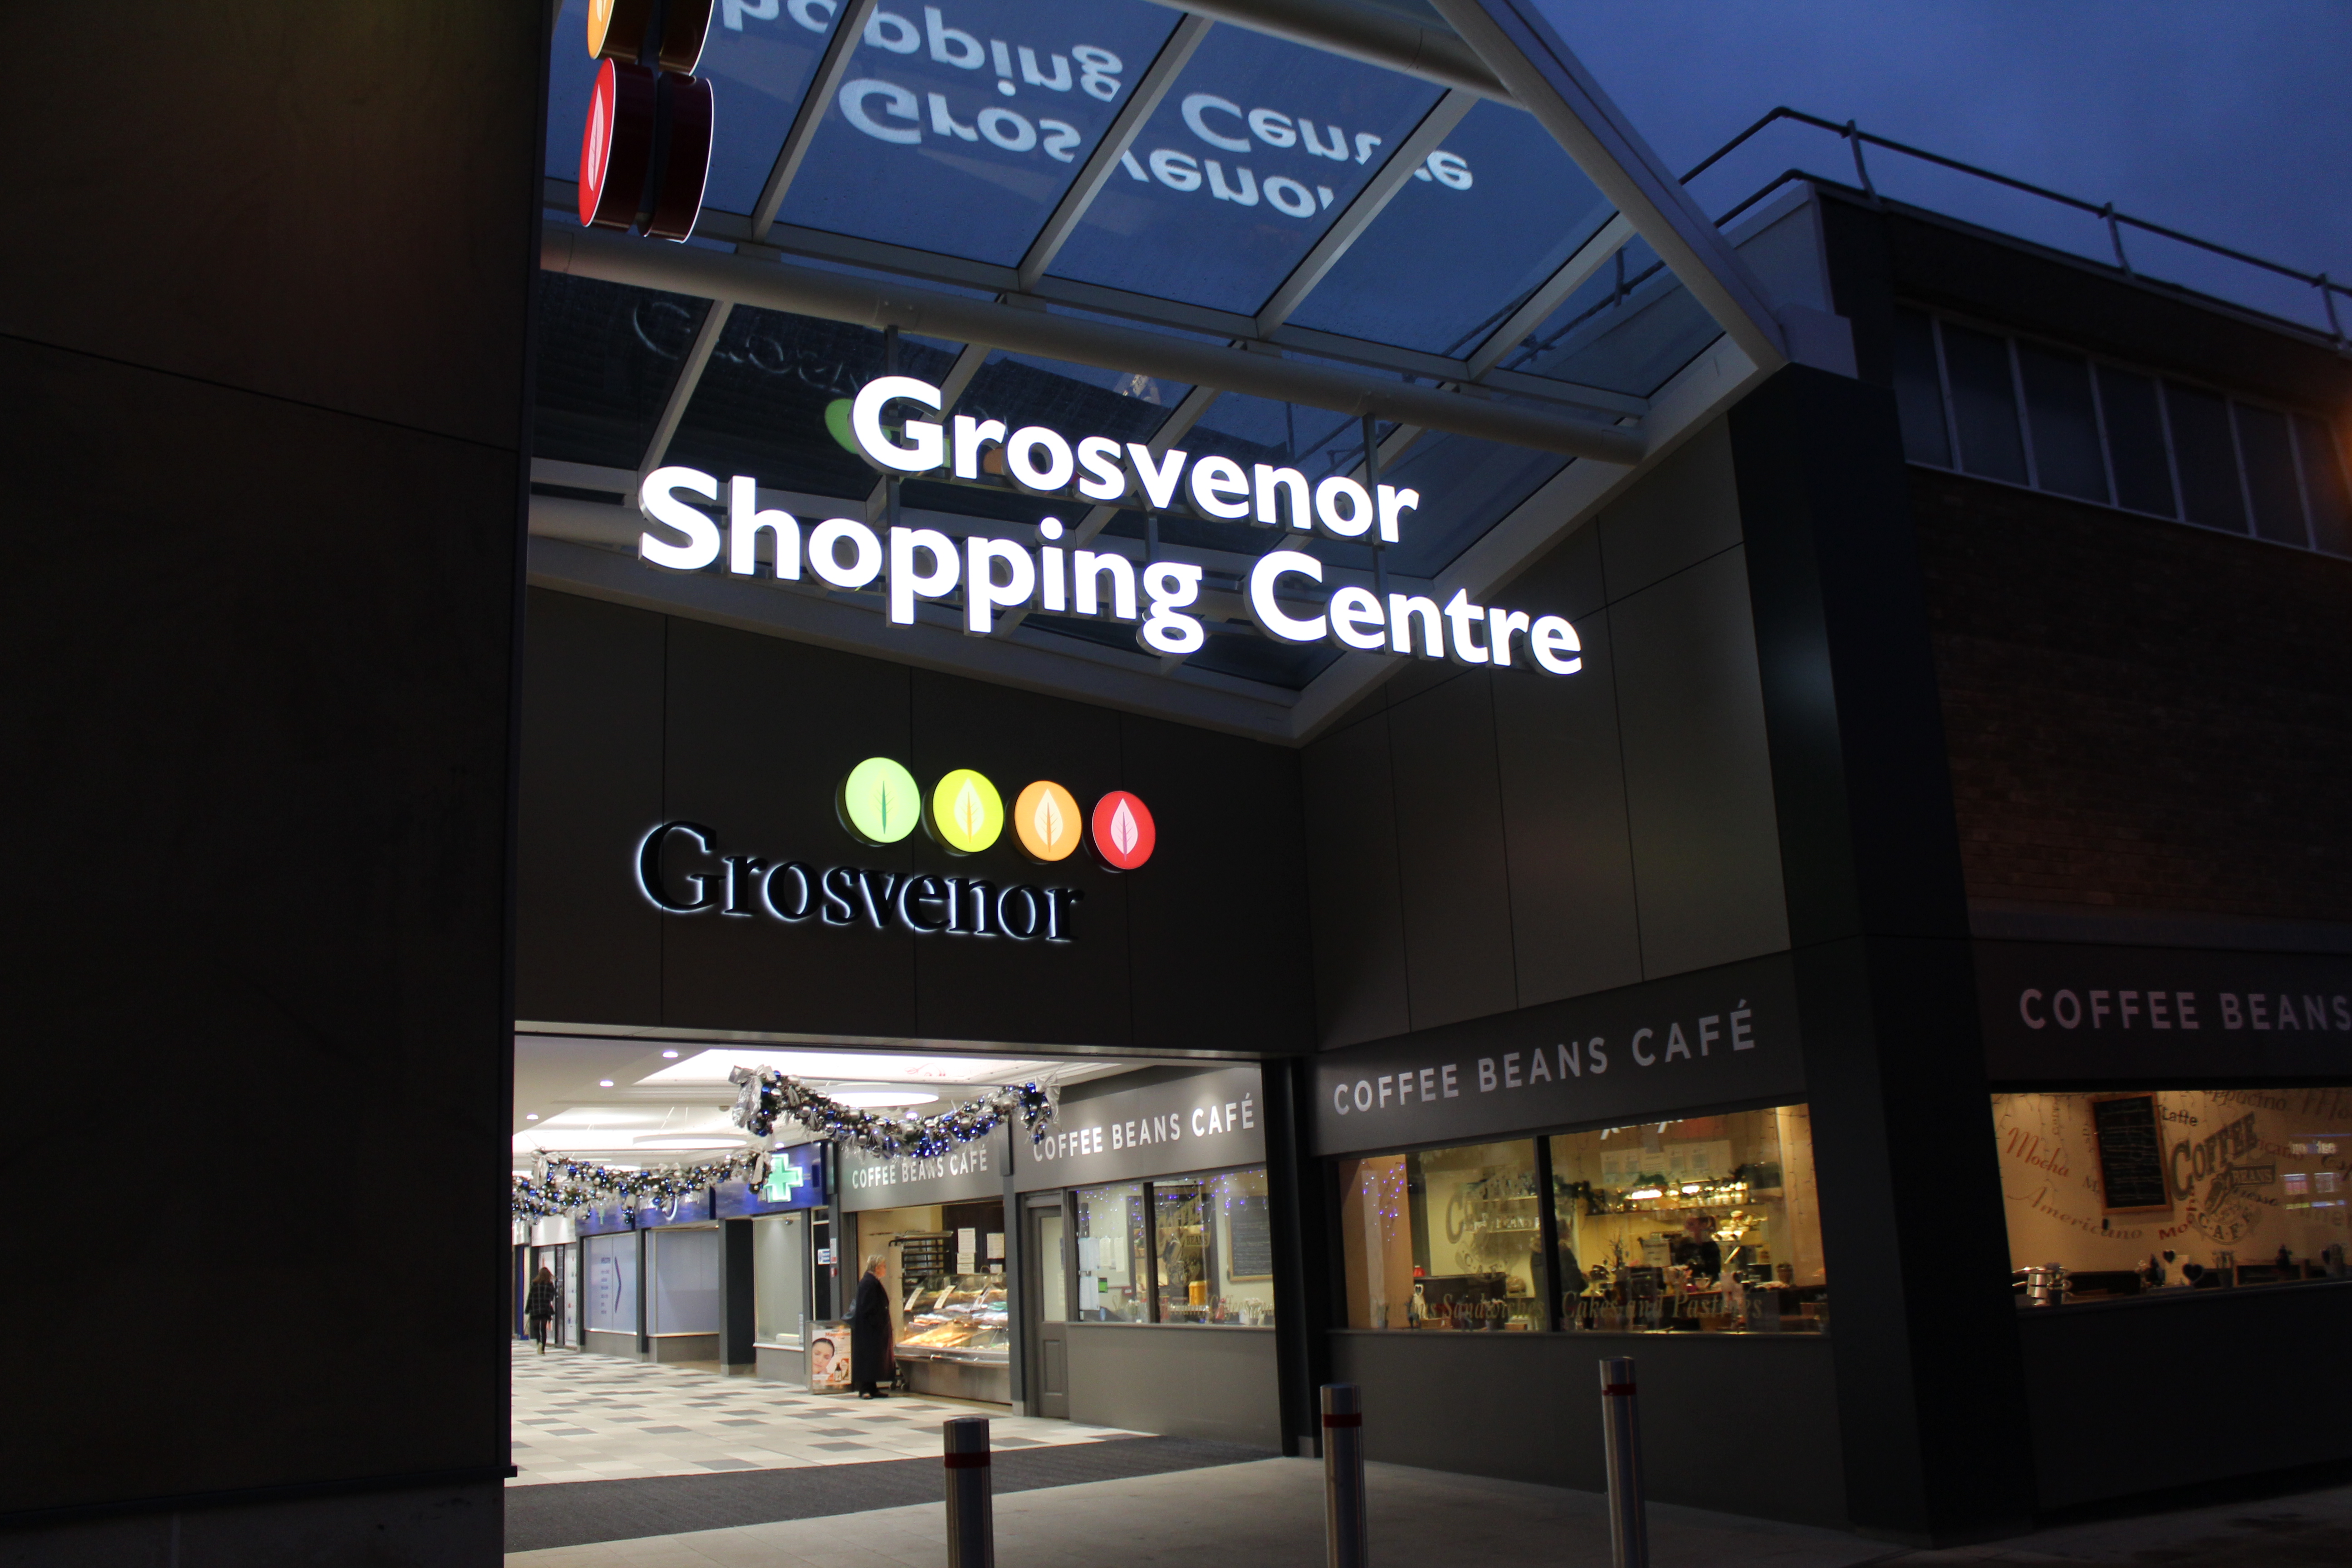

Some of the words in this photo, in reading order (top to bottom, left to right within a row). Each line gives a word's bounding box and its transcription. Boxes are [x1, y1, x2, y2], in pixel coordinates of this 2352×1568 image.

[852, 377, 1419, 542] Grosvenor
[640, 467, 1204, 653] Shopping
[1250, 551, 1582, 674] Centre
[637, 820, 1085, 942] Grosvenor
[2019, 988, 2201, 1029] COFFEE
[2219, 992, 2352, 1031] BEANS
[1333, 1063, 1459, 1115] COFFEE
[1478, 1037, 1607, 1092] BEANS
[1632, 999, 1755, 1067] CAFÉ
[1034, 1127, 1103, 1162] COFFEE
[1112, 1113, 1181, 1150] BEANS
[1192, 1093, 1254, 1137] CAFÉ
[2007, 1127, 2069, 1177] Mocha
[852, 1164, 896, 1189] COFFEE
[902, 1156, 944, 1183] BEANS
[950, 1144, 988, 1176] CAFÉ
[2007, 1187, 2142, 1239] Americano
